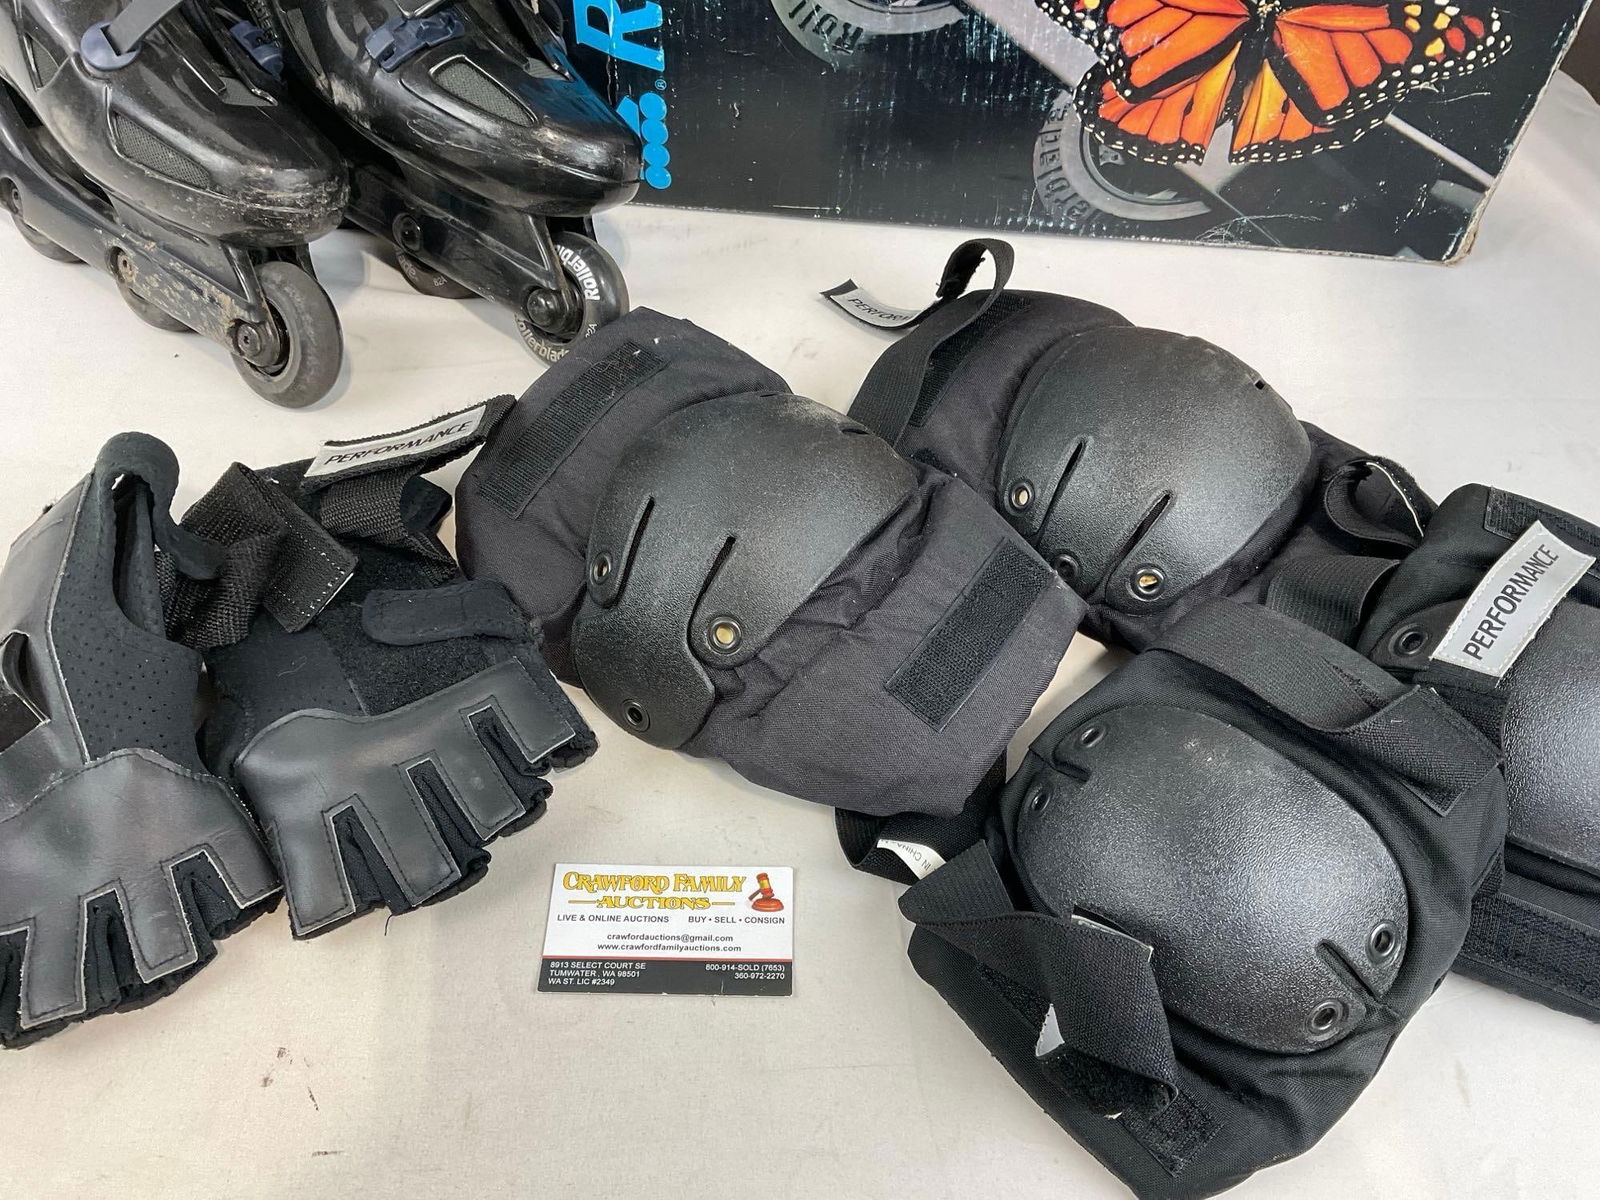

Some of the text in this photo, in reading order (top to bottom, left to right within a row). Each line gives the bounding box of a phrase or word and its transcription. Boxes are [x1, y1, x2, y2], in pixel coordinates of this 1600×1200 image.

[324, 420, 473, 466] PERFORMANCE
[1462, 543, 1560, 661] PERFORMANCE
[562, 871, 747, 895] CRAWFORD FAMILY
[595, 895, 712, 911] AUCTIONS
[556, 913, 670, 923] LIVE & ONLINE AUCTIONS
[688, 915, 786, 925] BUY SELL CONSIGN
[606, 932, 734, 943] crawfordauctions@gmail.com
[597, 942, 742, 953] www.crawfordfamilyauctions.com
[549, 961, 647, 970] 8913 SELECT COURT SE
[705, 963, 785, 972] 800-914-SOLD (7653)
[602, 970, 616, 978] WA
[617, 970, 641, 978] 98501
[734, 972, 785, 981] 360-972-2270
[548, 978, 616, 987] WA ST. LIC #2349
